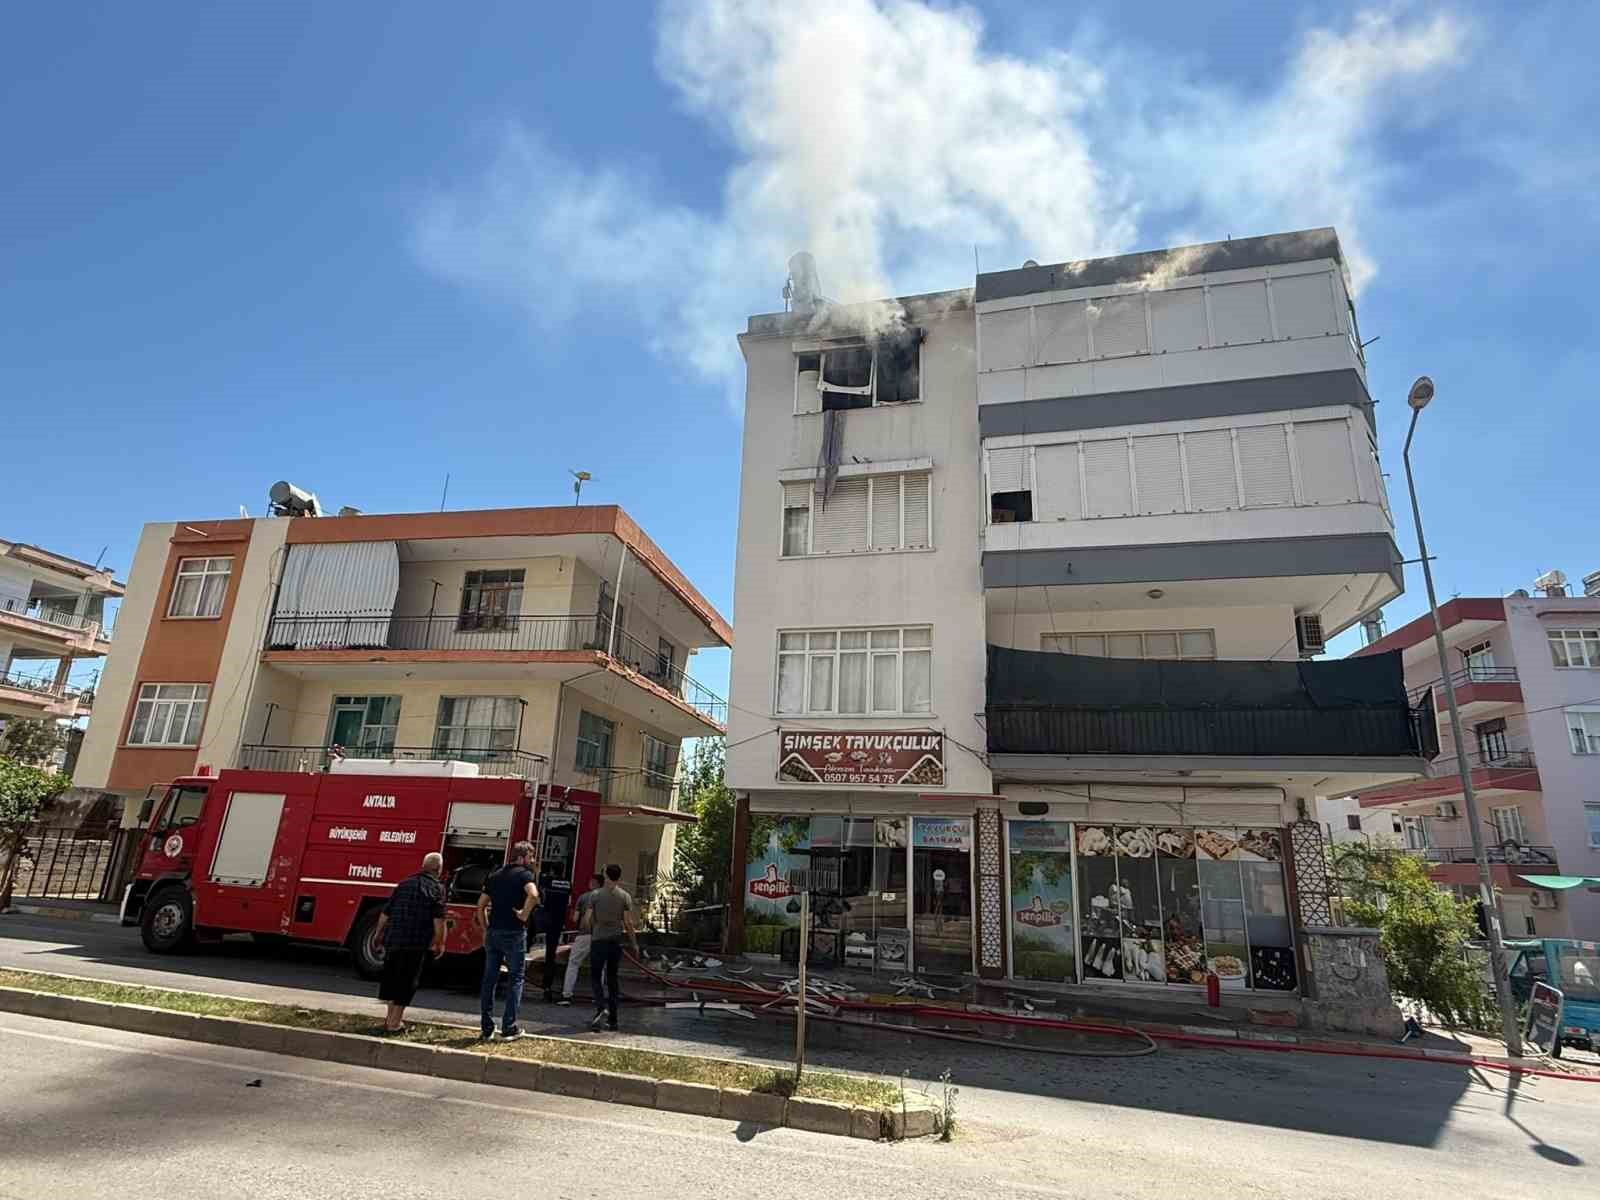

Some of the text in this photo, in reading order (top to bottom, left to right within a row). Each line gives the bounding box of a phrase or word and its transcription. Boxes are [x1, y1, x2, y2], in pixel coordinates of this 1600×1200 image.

[784, 733, 940, 752] ŞİMŞEK TAVUKÇULUK
[824, 773, 895, 783] 0507 957 54 75
[363, 794, 396, 809] ANTALYA
[329, 826, 417, 843] BÜYÜKŞEHİR BELEDİYESİ
[348, 863, 383, 878] İTFAİYE
